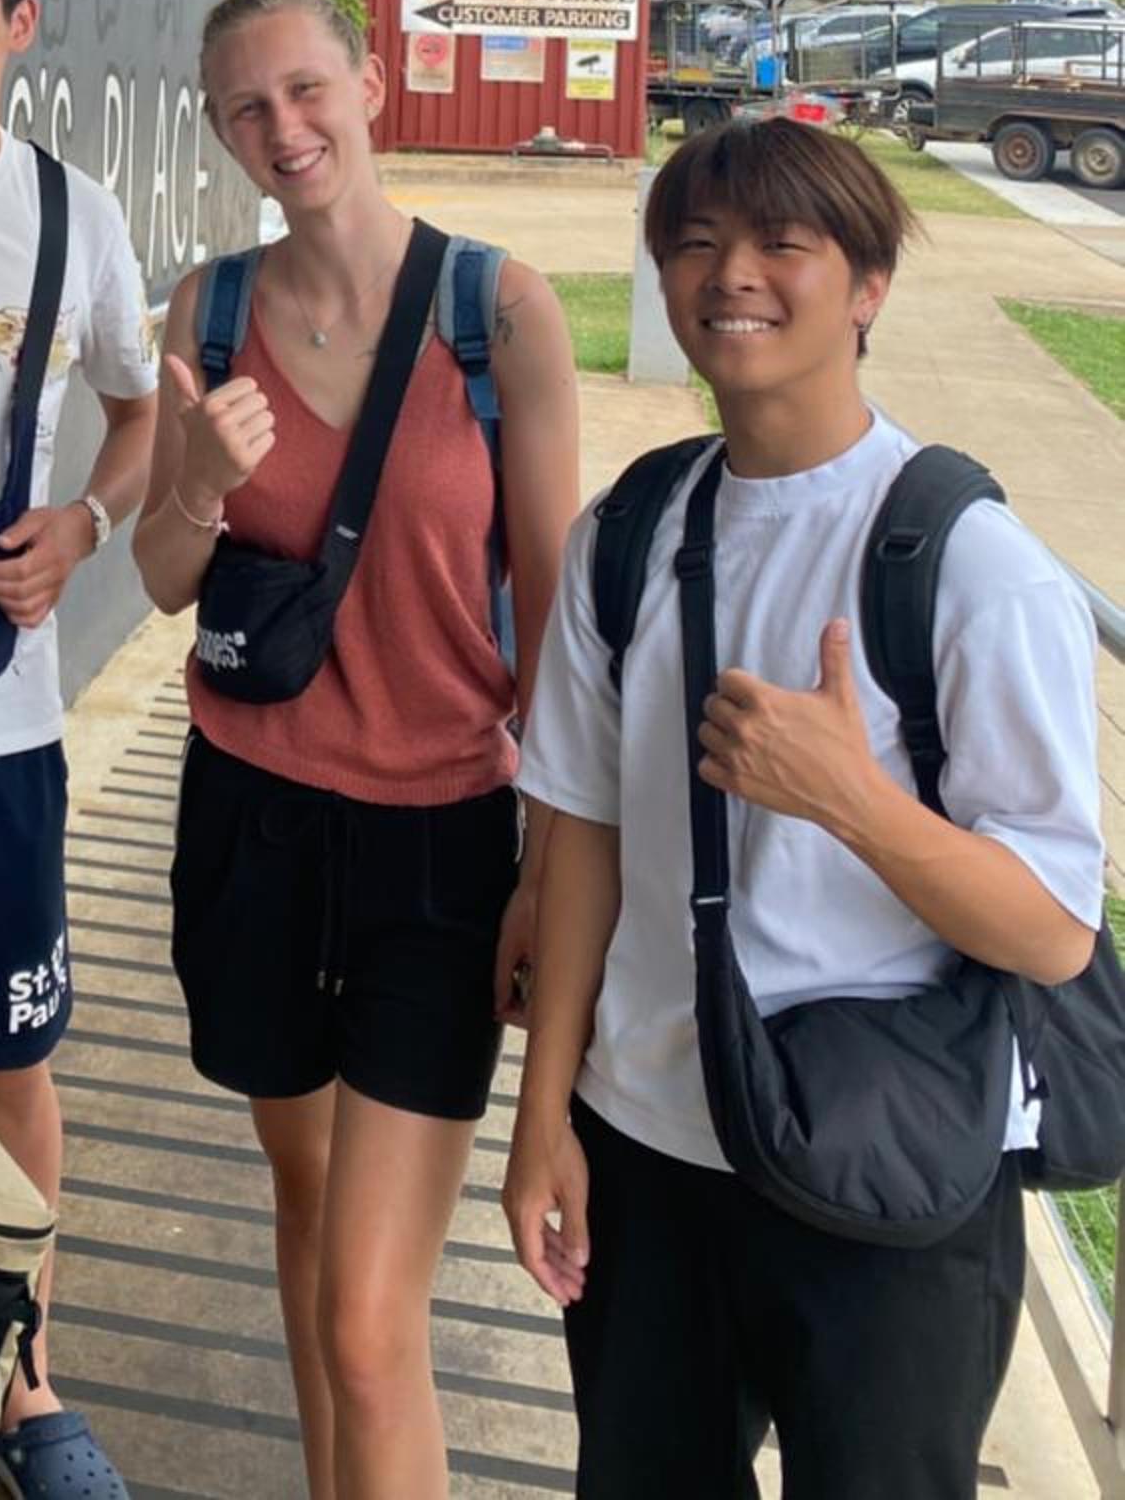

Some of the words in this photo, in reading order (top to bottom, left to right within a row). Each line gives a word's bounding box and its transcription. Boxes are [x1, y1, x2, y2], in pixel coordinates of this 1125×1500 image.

[438, 5, 539, 26] CUSTOMER
[544, 7, 627, 28] PARKING
[9, 964, 51, 1002] St.
